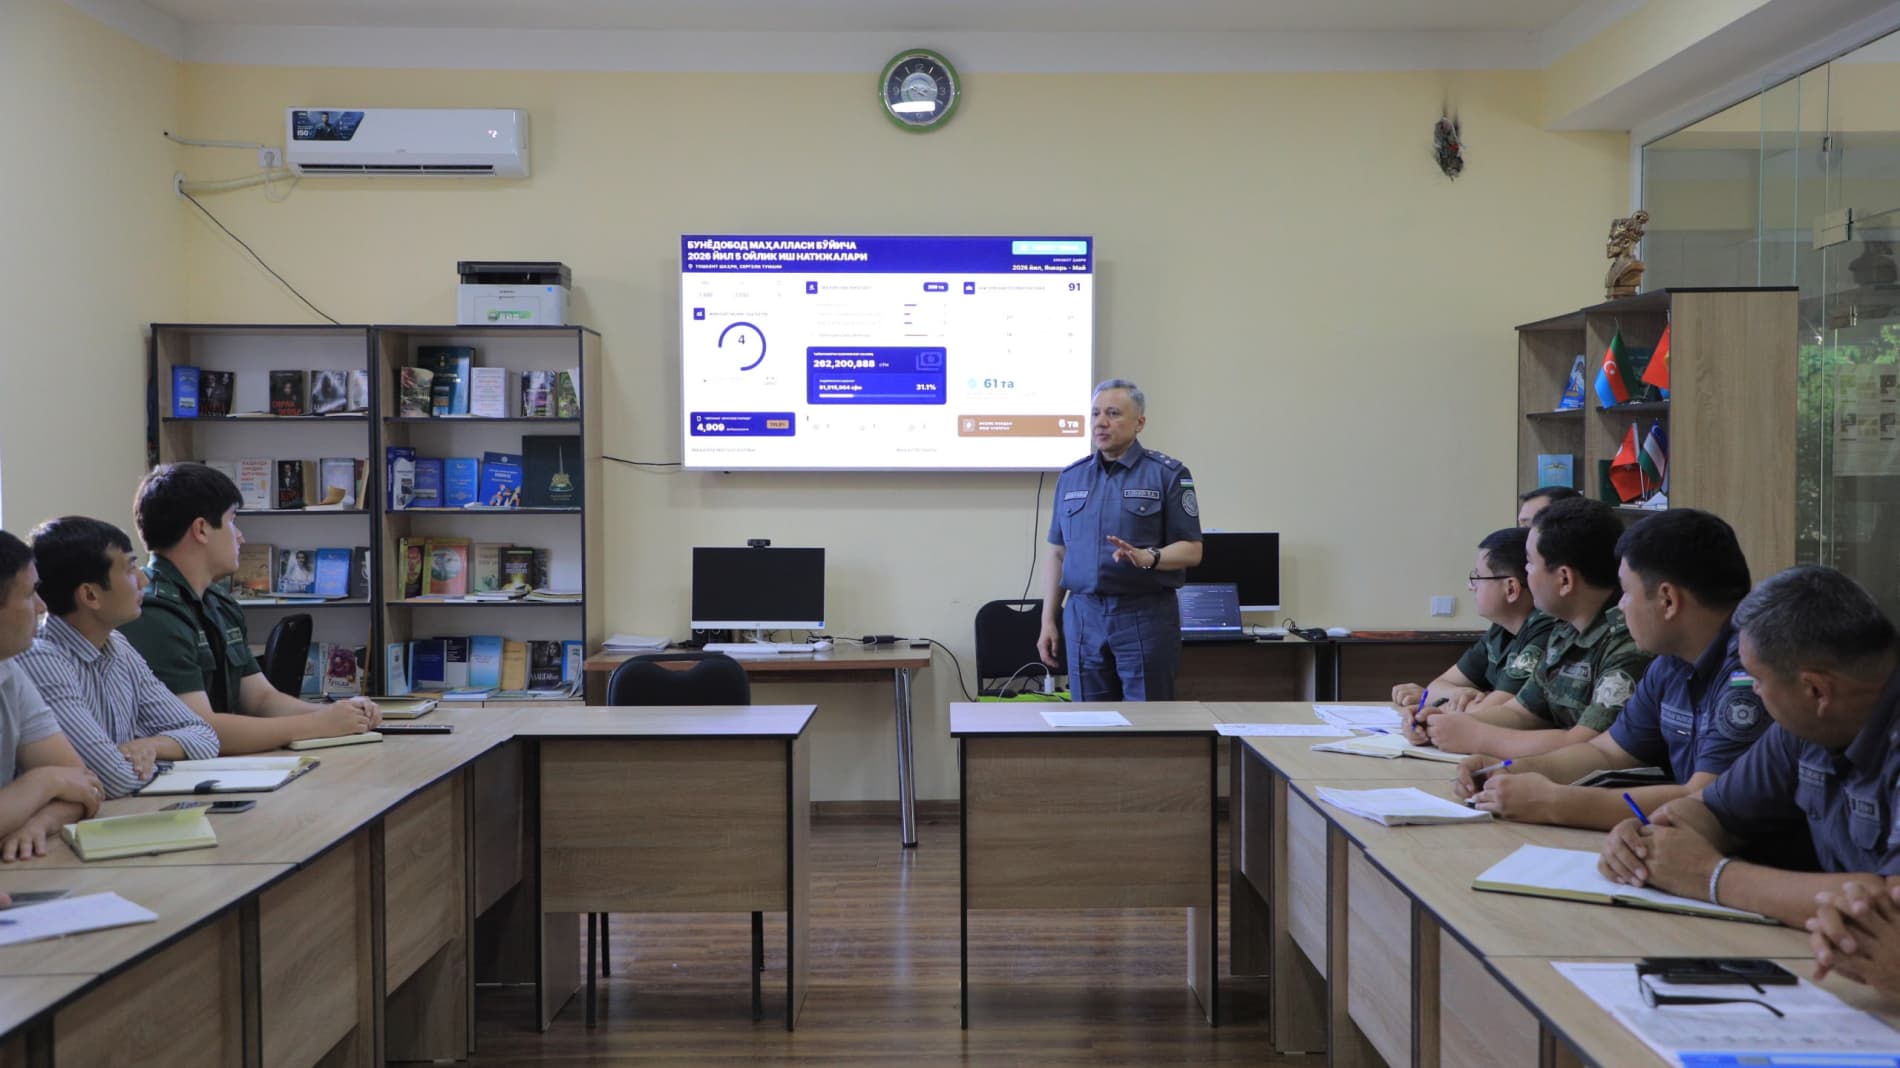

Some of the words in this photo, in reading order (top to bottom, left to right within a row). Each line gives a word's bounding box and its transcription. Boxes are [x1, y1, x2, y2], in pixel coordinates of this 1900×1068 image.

[688, 239, 748, 250] БУНЁДОБОД
[749, 240, 815, 251] МАҲАЛЛАСИ
[815, 239, 857, 250] БЎЙИЧА
[712, 251, 734, 261] ЙИЛ
[735, 253, 742, 261] 5
[742, 251, 777, 262] ОЙЛИК
[778, 253, 796, 262] ИШ
[796, 253, 868, 262] НАТИЖАЛАРИ
[1068, 283, 1081, 291] 91
[738, 335, 746, 344] 4
[984, 378, 998, 388] 61
[1000, 380, 1015, 388] та
[1067, 420, 1079, 428] та
